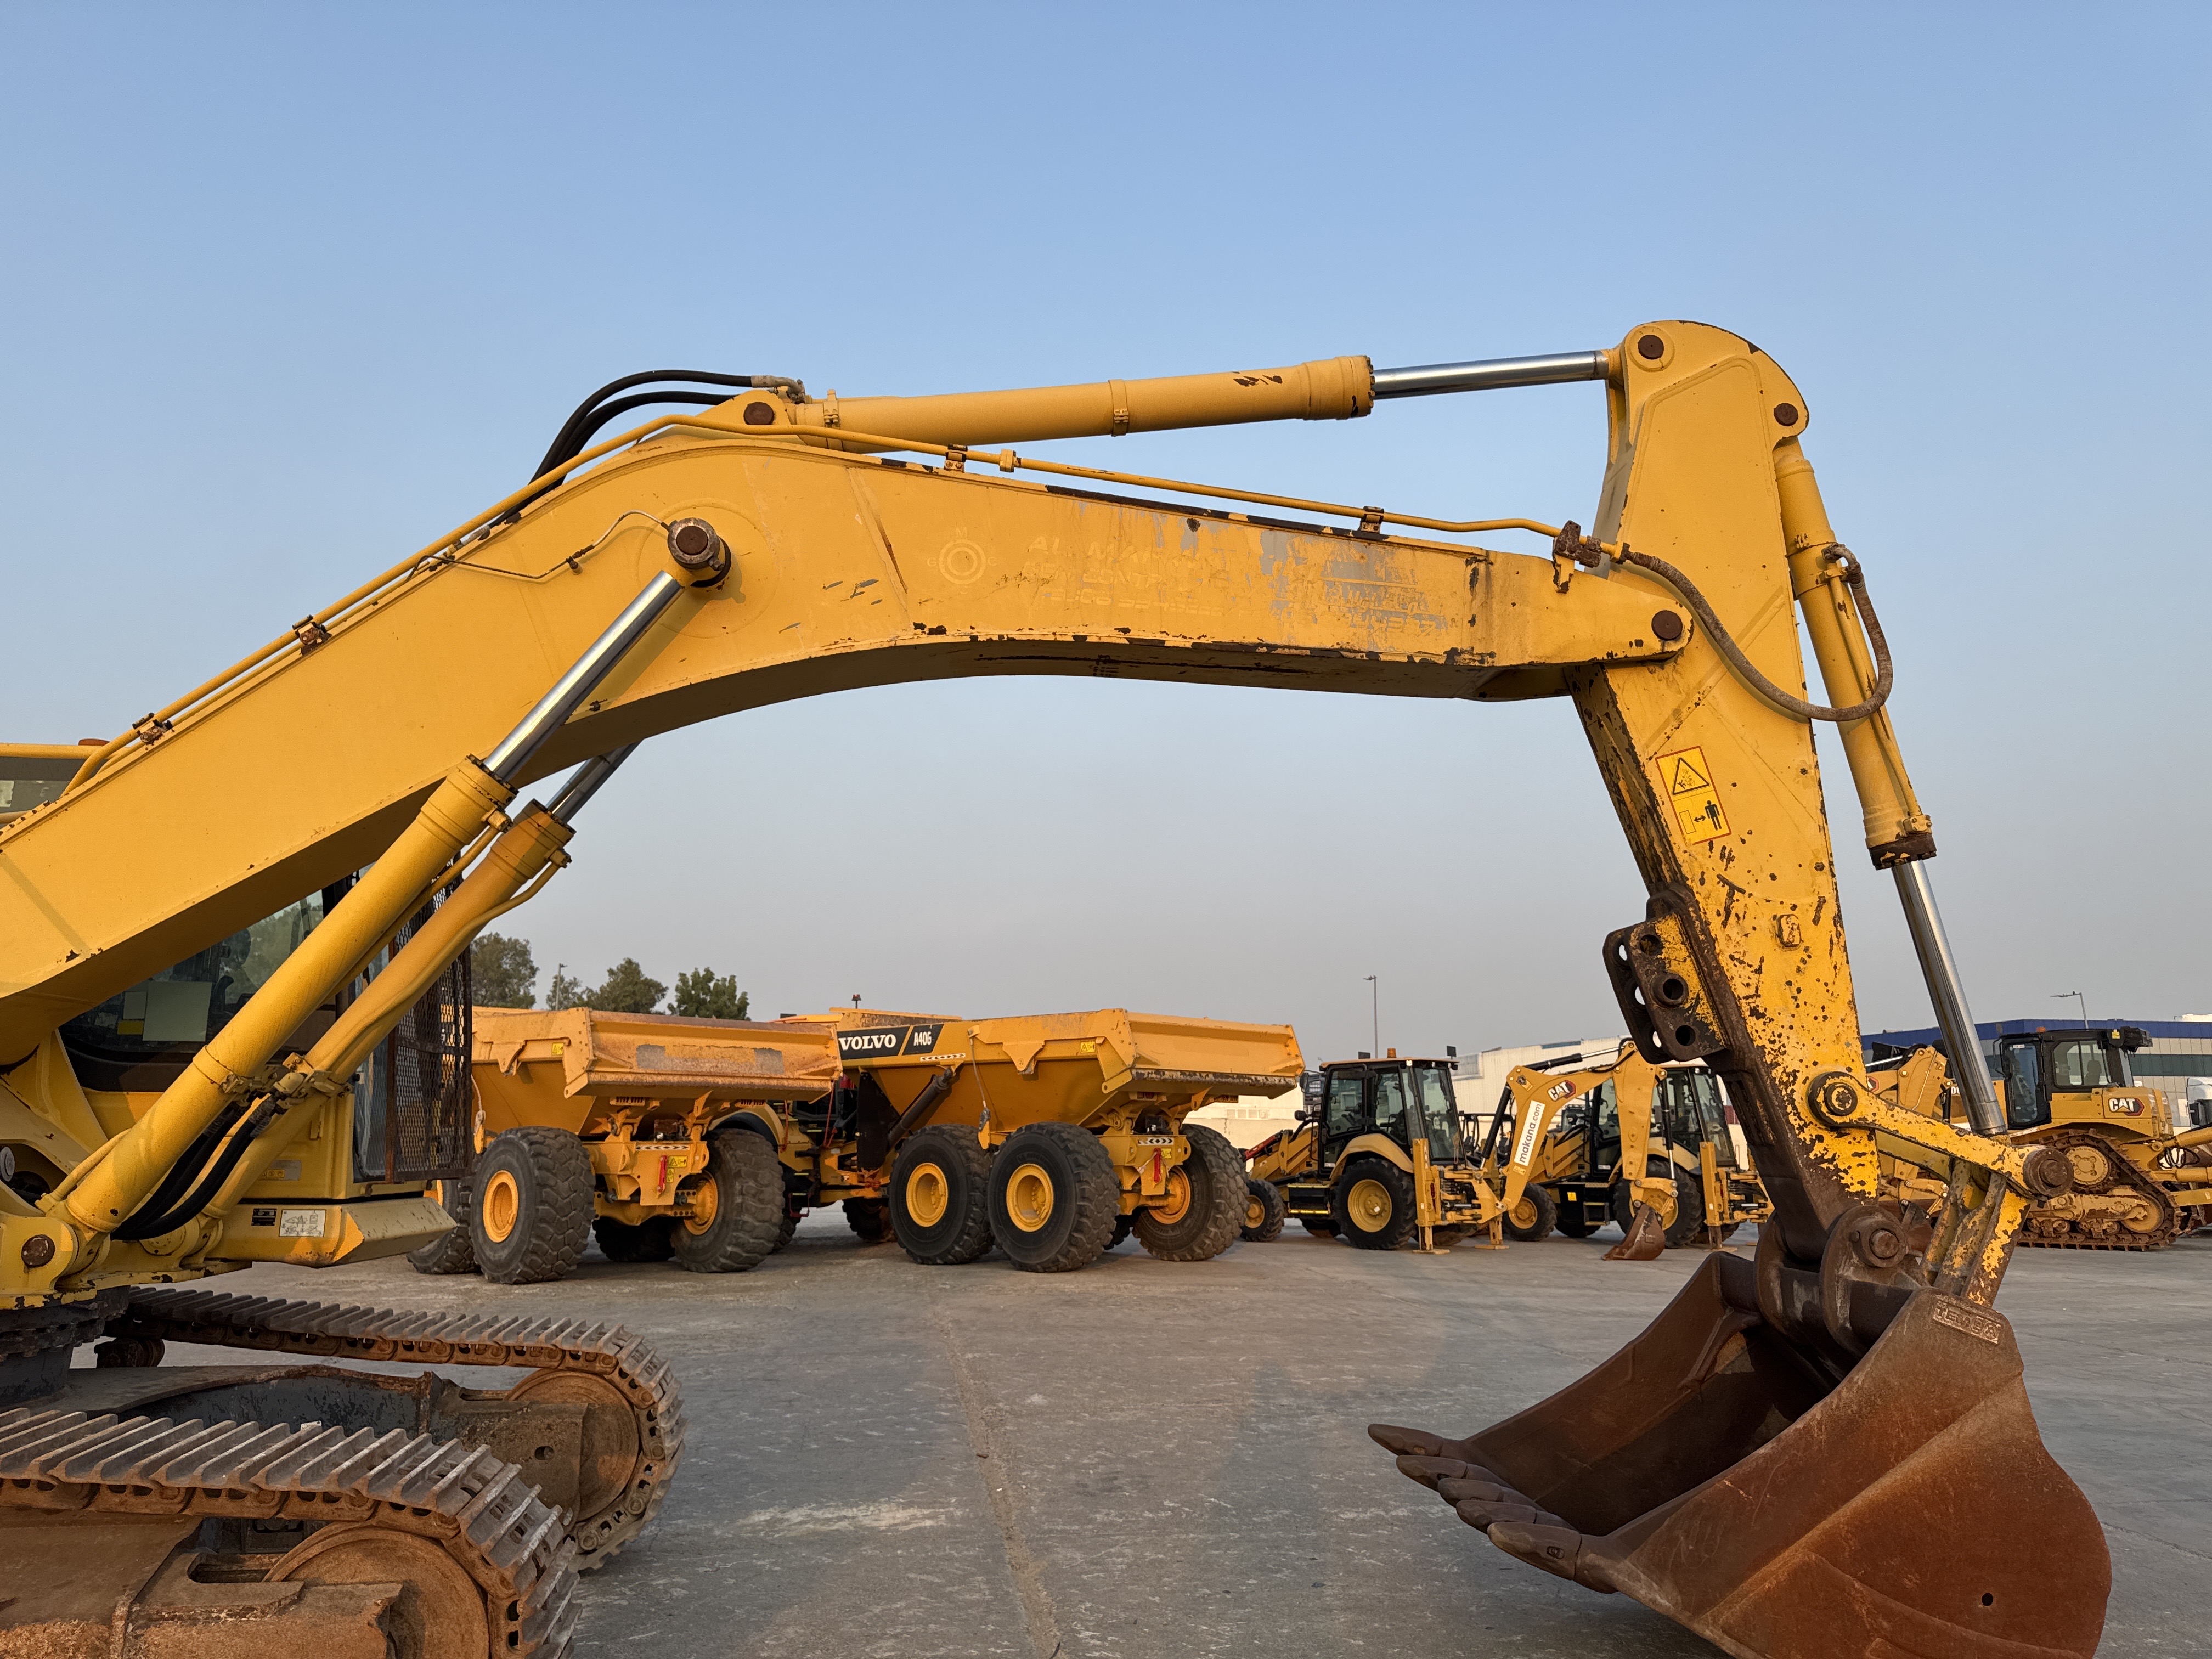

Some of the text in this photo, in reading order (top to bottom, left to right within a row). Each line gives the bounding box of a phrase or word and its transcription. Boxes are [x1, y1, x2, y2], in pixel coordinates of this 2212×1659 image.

[838, 1034, 896, 1051] VOLVO
[913, 1031, 932, 1047] A40G
[1548, 1081, 1570, 1101] CAT
[2109, 1098, 2135, 1112] CAT
[1519, 1104, 1542, 1163] makana.com
